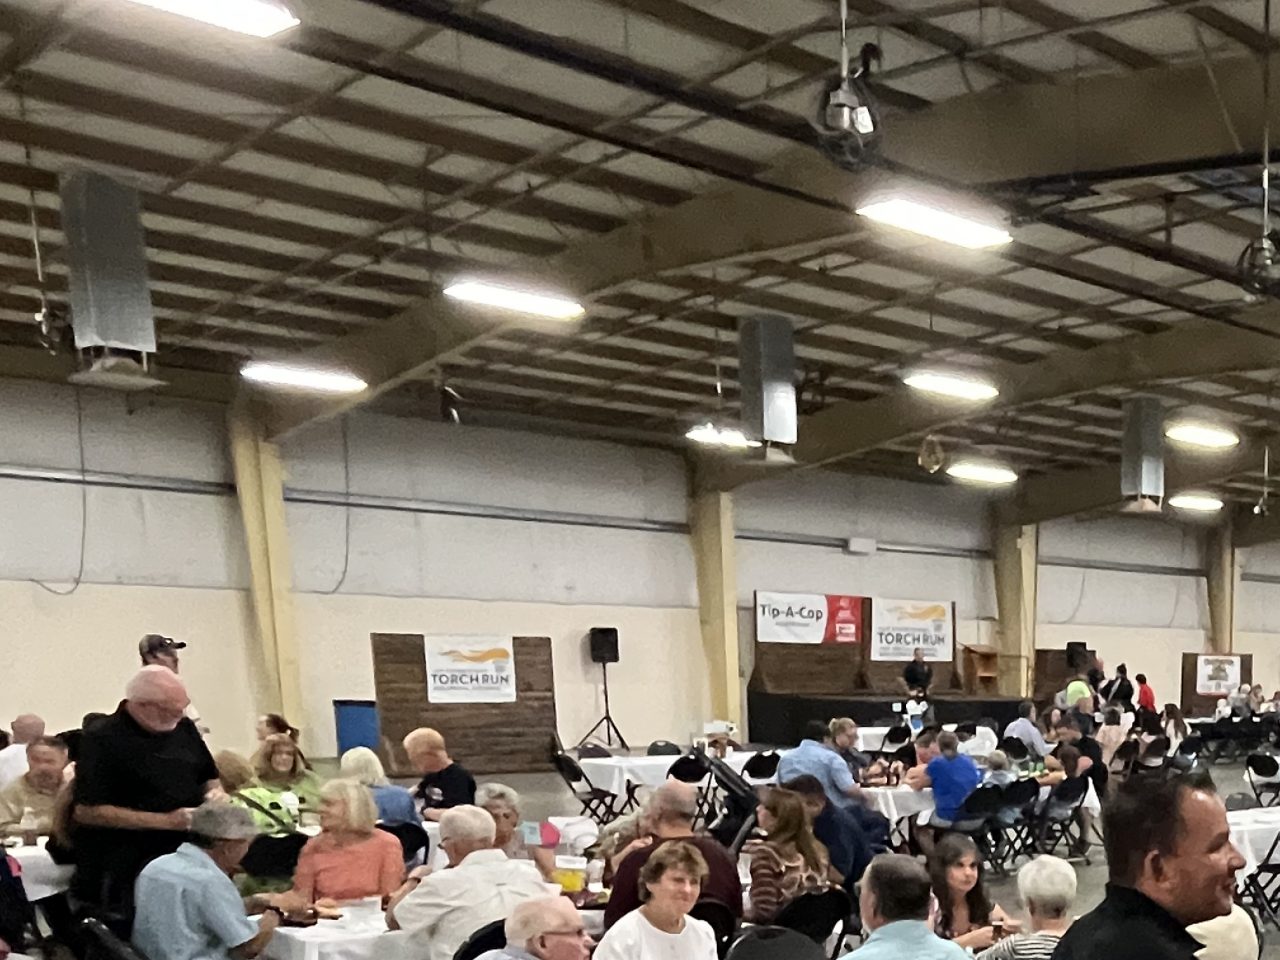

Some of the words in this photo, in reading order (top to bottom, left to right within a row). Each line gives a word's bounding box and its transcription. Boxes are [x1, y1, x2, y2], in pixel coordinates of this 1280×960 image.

[760, 603, 824, 623] Tip-A-Cop
[877, 632, 921, 646] TORCH
[922, 633, 945, 646] RUN
[430, 673, 479, 685] TORCH
[481, 673, 510, 685] RUN
